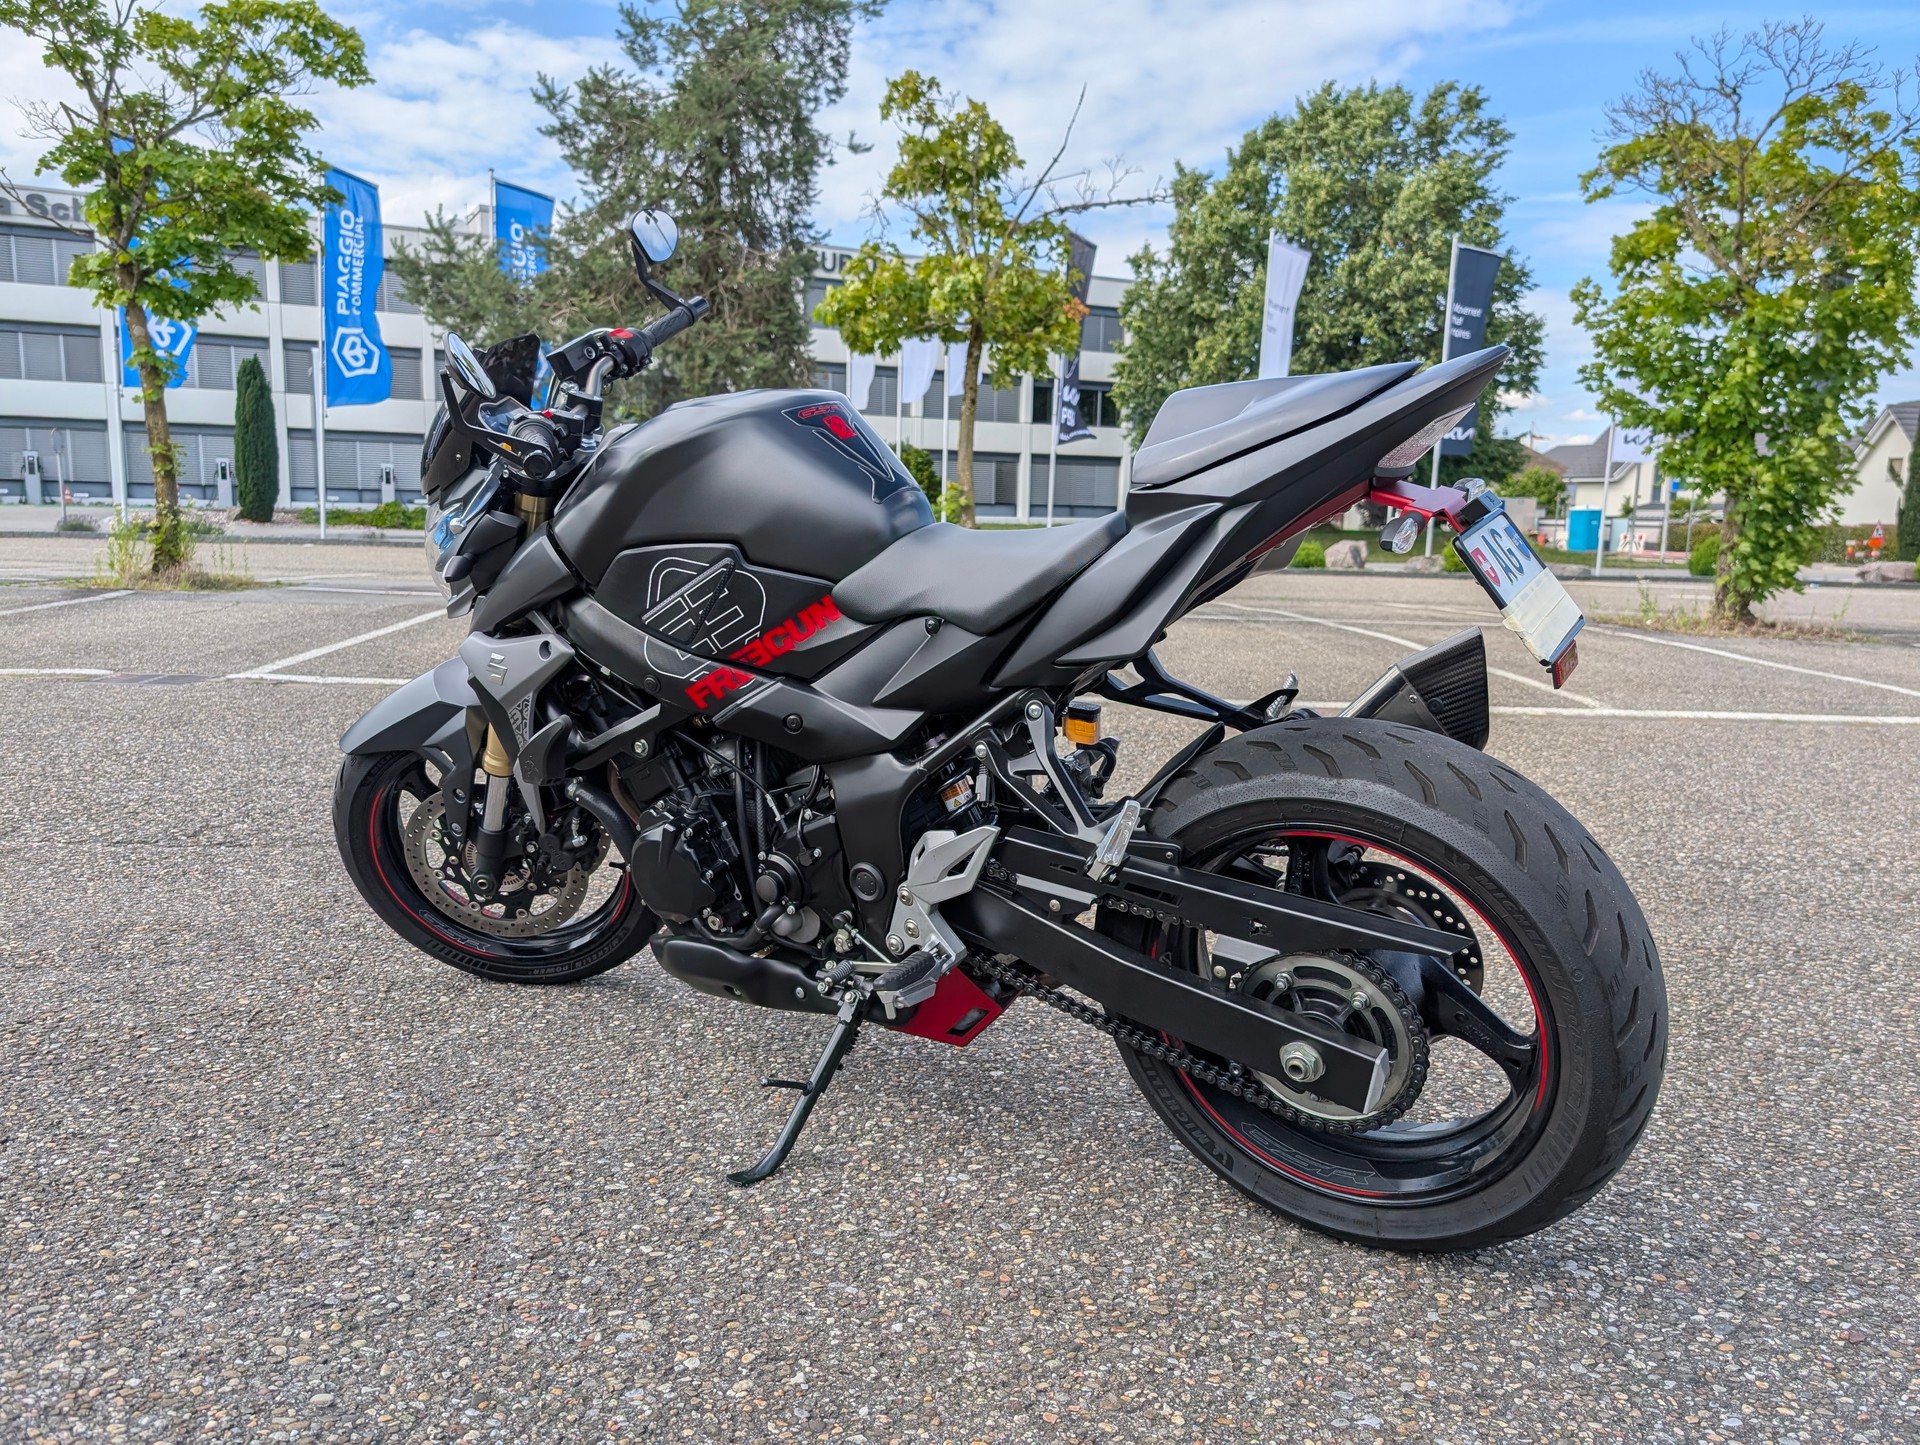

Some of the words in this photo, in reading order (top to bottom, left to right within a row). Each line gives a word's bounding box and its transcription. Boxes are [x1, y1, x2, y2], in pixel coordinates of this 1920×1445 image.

[336, 209, 355, 316] PIAGGIO
[351, 215, 365, 316] COMMERCIAL
[1481, 528, 1525, 586] AG
[533, 964, 569, 976] POWER
[574, 937, 620, 969] MICHELIN
[1138, 1054, 1211, 1146] MICHELIN
